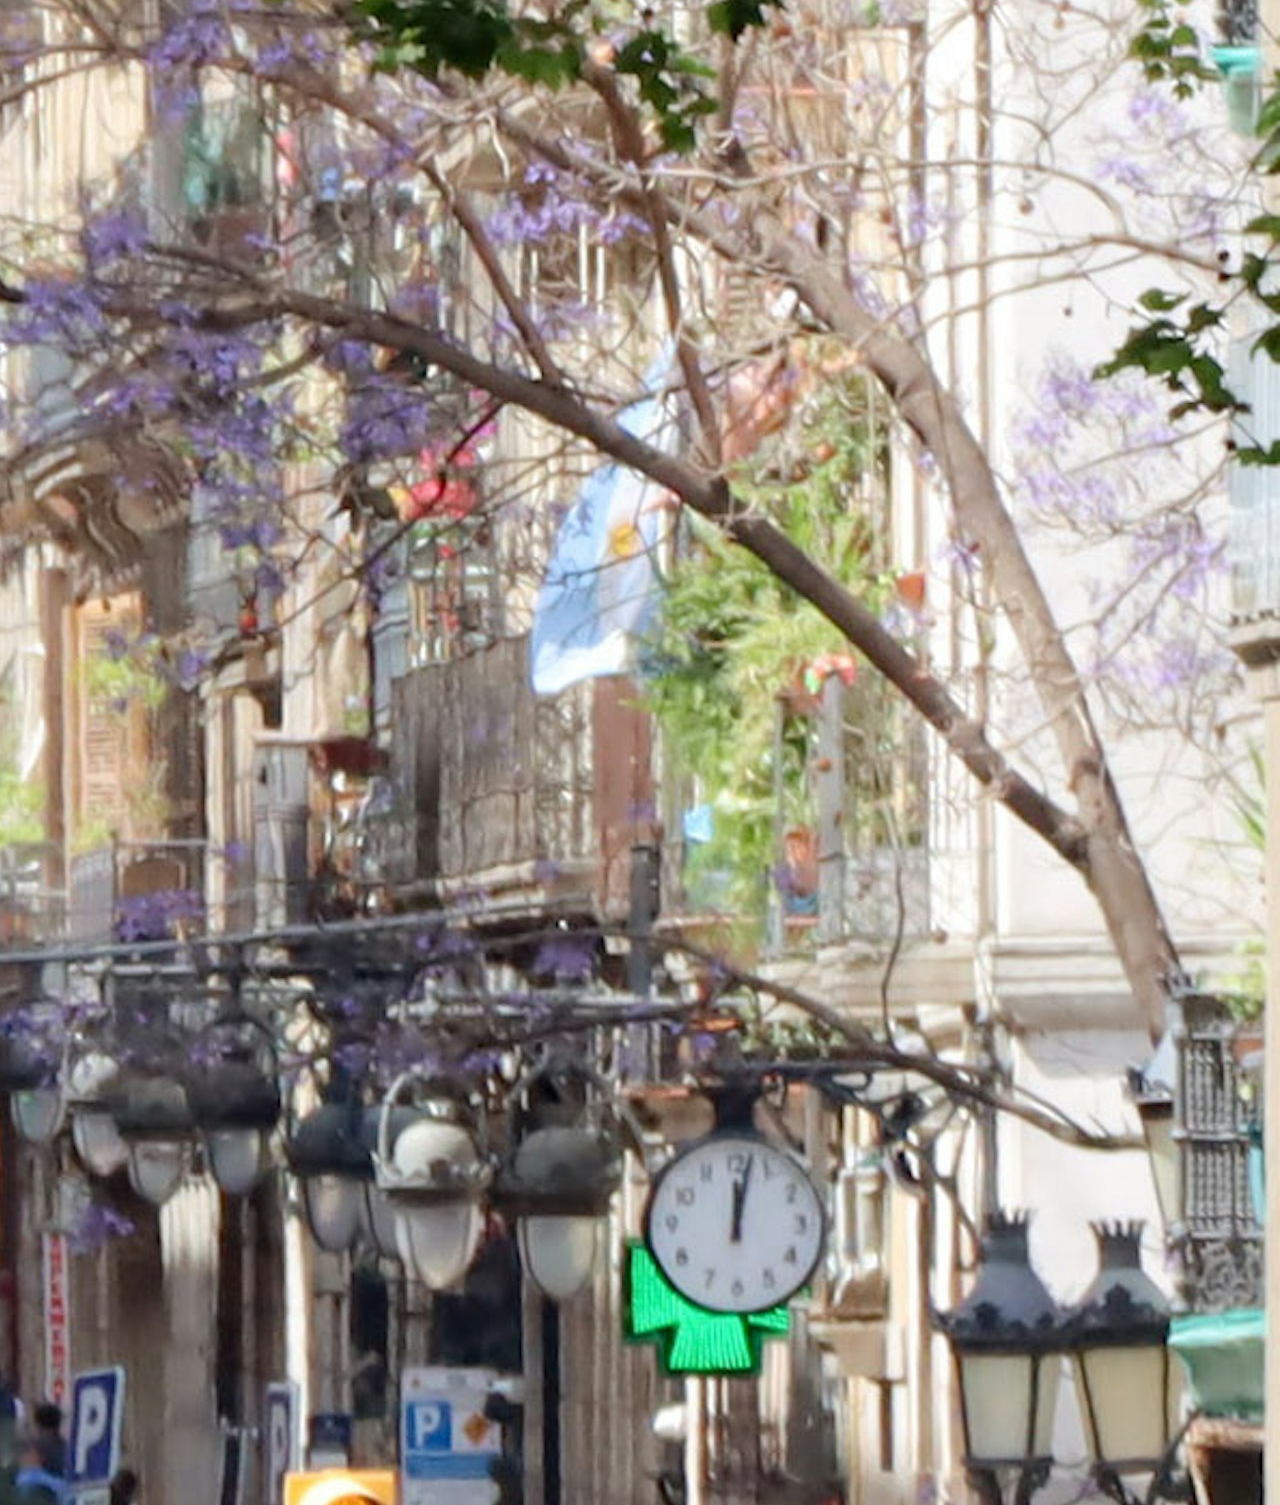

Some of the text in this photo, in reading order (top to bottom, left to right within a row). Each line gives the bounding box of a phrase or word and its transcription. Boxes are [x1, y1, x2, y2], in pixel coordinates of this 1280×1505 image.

[701, 1163, 712, 1181] 11
[728, 1154, 744, 1173] 12
[762, 1158, 771, 1180] 1
[676, 1188, 694, 1206] 10
[786, 1183, 797, 1204] 2
[666, 1215, 678, 1233] 9
[795, 1215, 807, 1235] 3
[676, 1248, 688, 1266] 8
[784, 1246, 796, 1263] 4
[704, 1268, 715, 1289] 7
[763, 1267, 775, 1288] 5
[731, 1279, 743, 1297] 6
[76, 1386, 108, 1474] P
[416, 1406, 440, 1448] P
